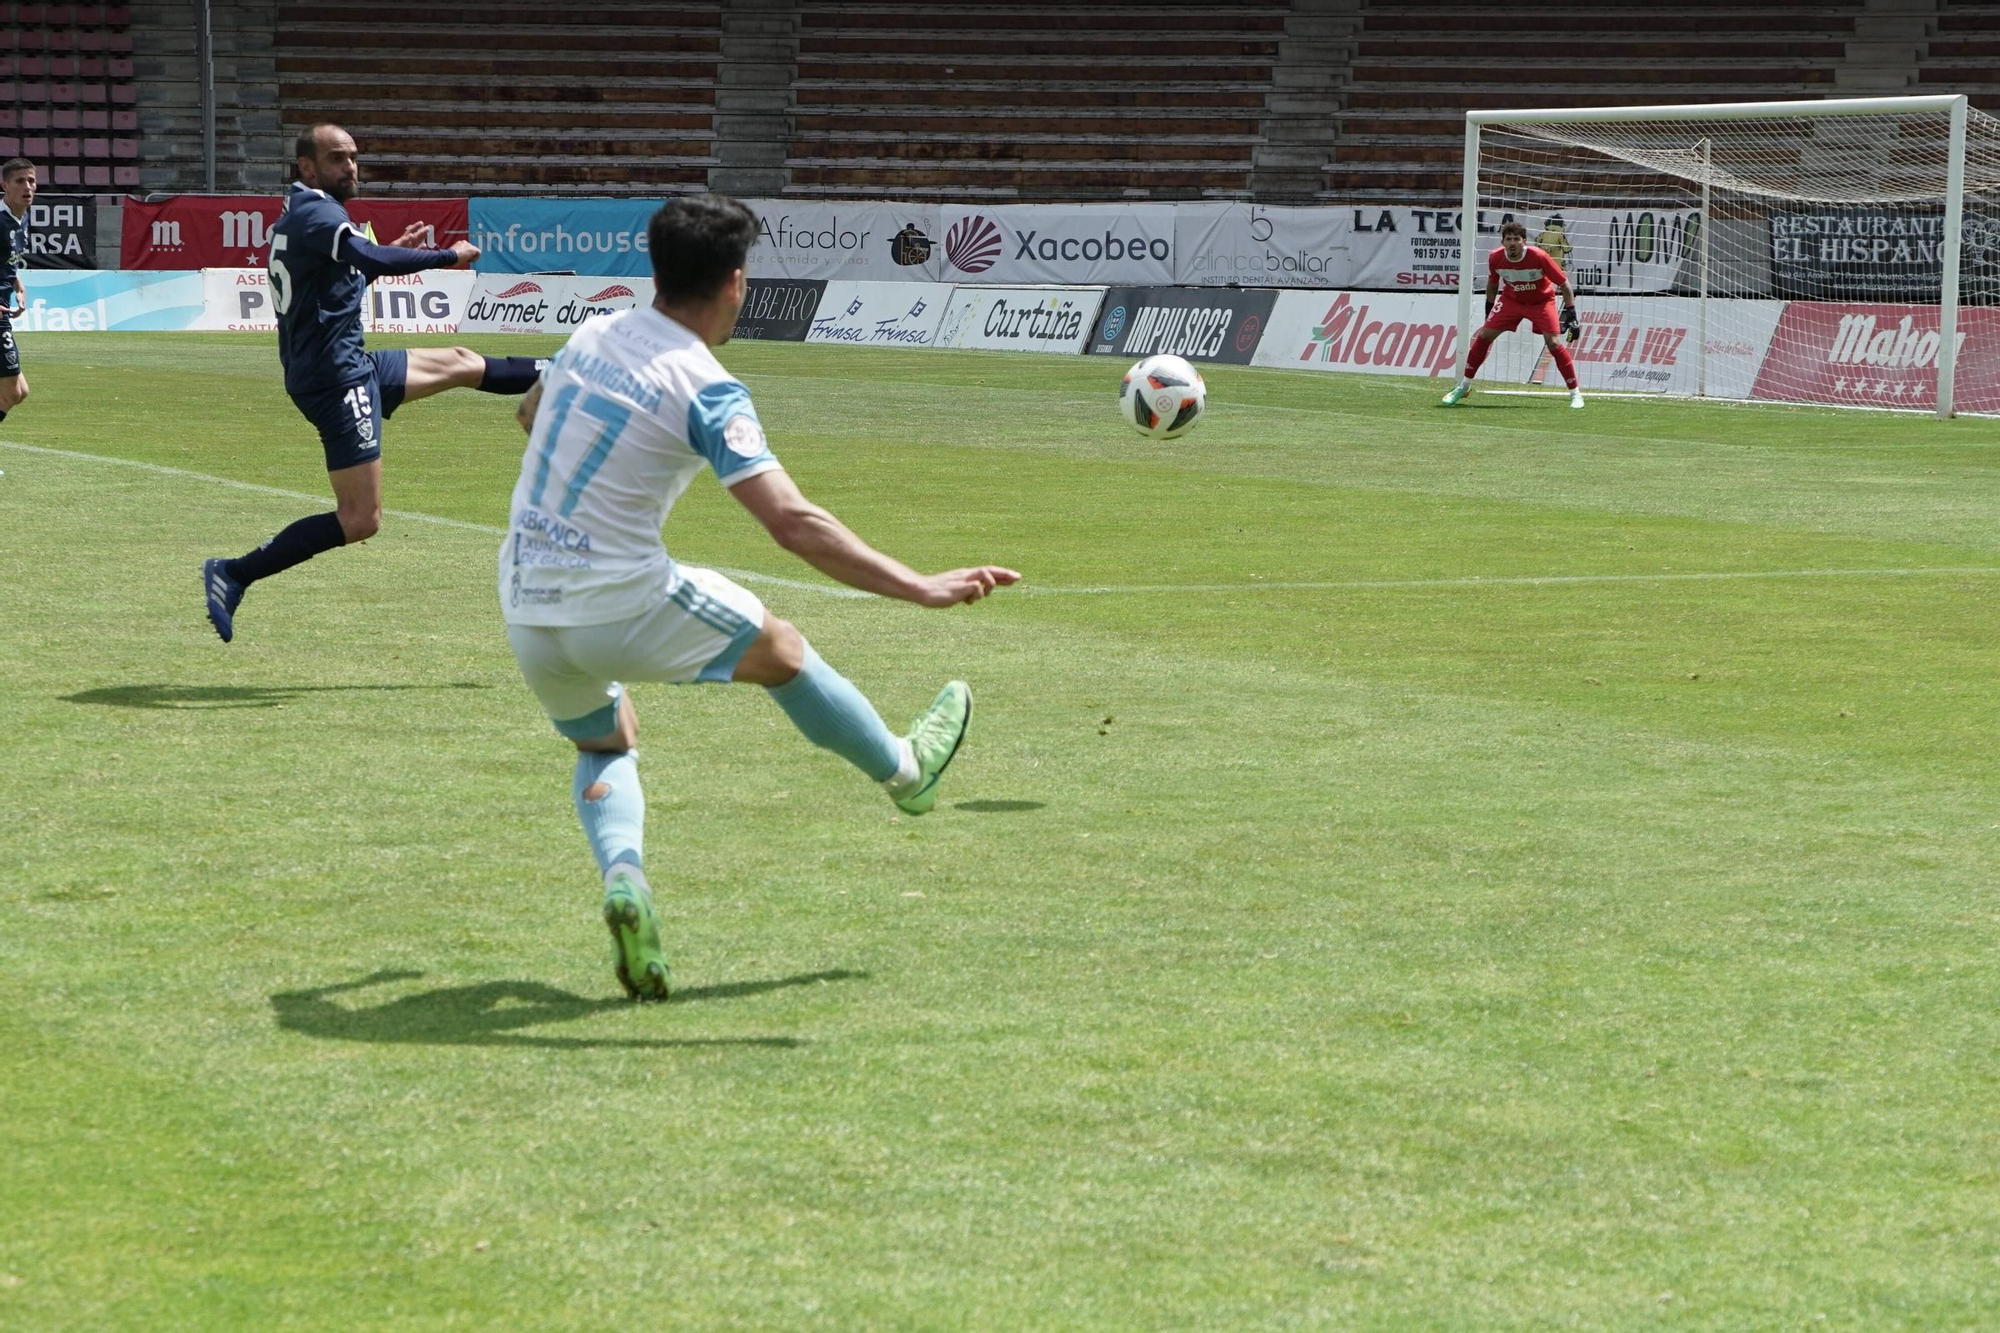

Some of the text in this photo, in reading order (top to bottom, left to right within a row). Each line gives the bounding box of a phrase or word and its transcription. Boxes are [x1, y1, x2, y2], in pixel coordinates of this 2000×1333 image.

[30, 205, 83, 227] DAI
[1354, 210, 1396, 232] LA
[478, 223, 650, 254] inforhouse
[751, 215, 871, 249] Afiador
[1015, 230, 1170, 261] Xacobeo
[770, 253, 818, 264] comida
[837, 255, 870, 266] vinos
[1773, 238, 1811, 262] EL
[1201, 275, 1329, 286] INSTITUTO DENTAL AVANZADO
[1396, 272, 1460, 286] SHAR
[1577, 264, 1602, 290] pub
[9, 298, 107, 331] afael
[467, 296, 549, 325] durmet
[984, 298, 1082, 341] Curtiña
[2, 331, 13, 349] 3
[808, 317, 870, 342] Frinsa
[870, 318, 933, 344] Frinsa
[1122, 306, 1233, 358] IMPULSO23
[1639, 327, 1687, 366] VOZ
[344, 386, 372, 419] 15
[528, 384, 632, 519] 17
